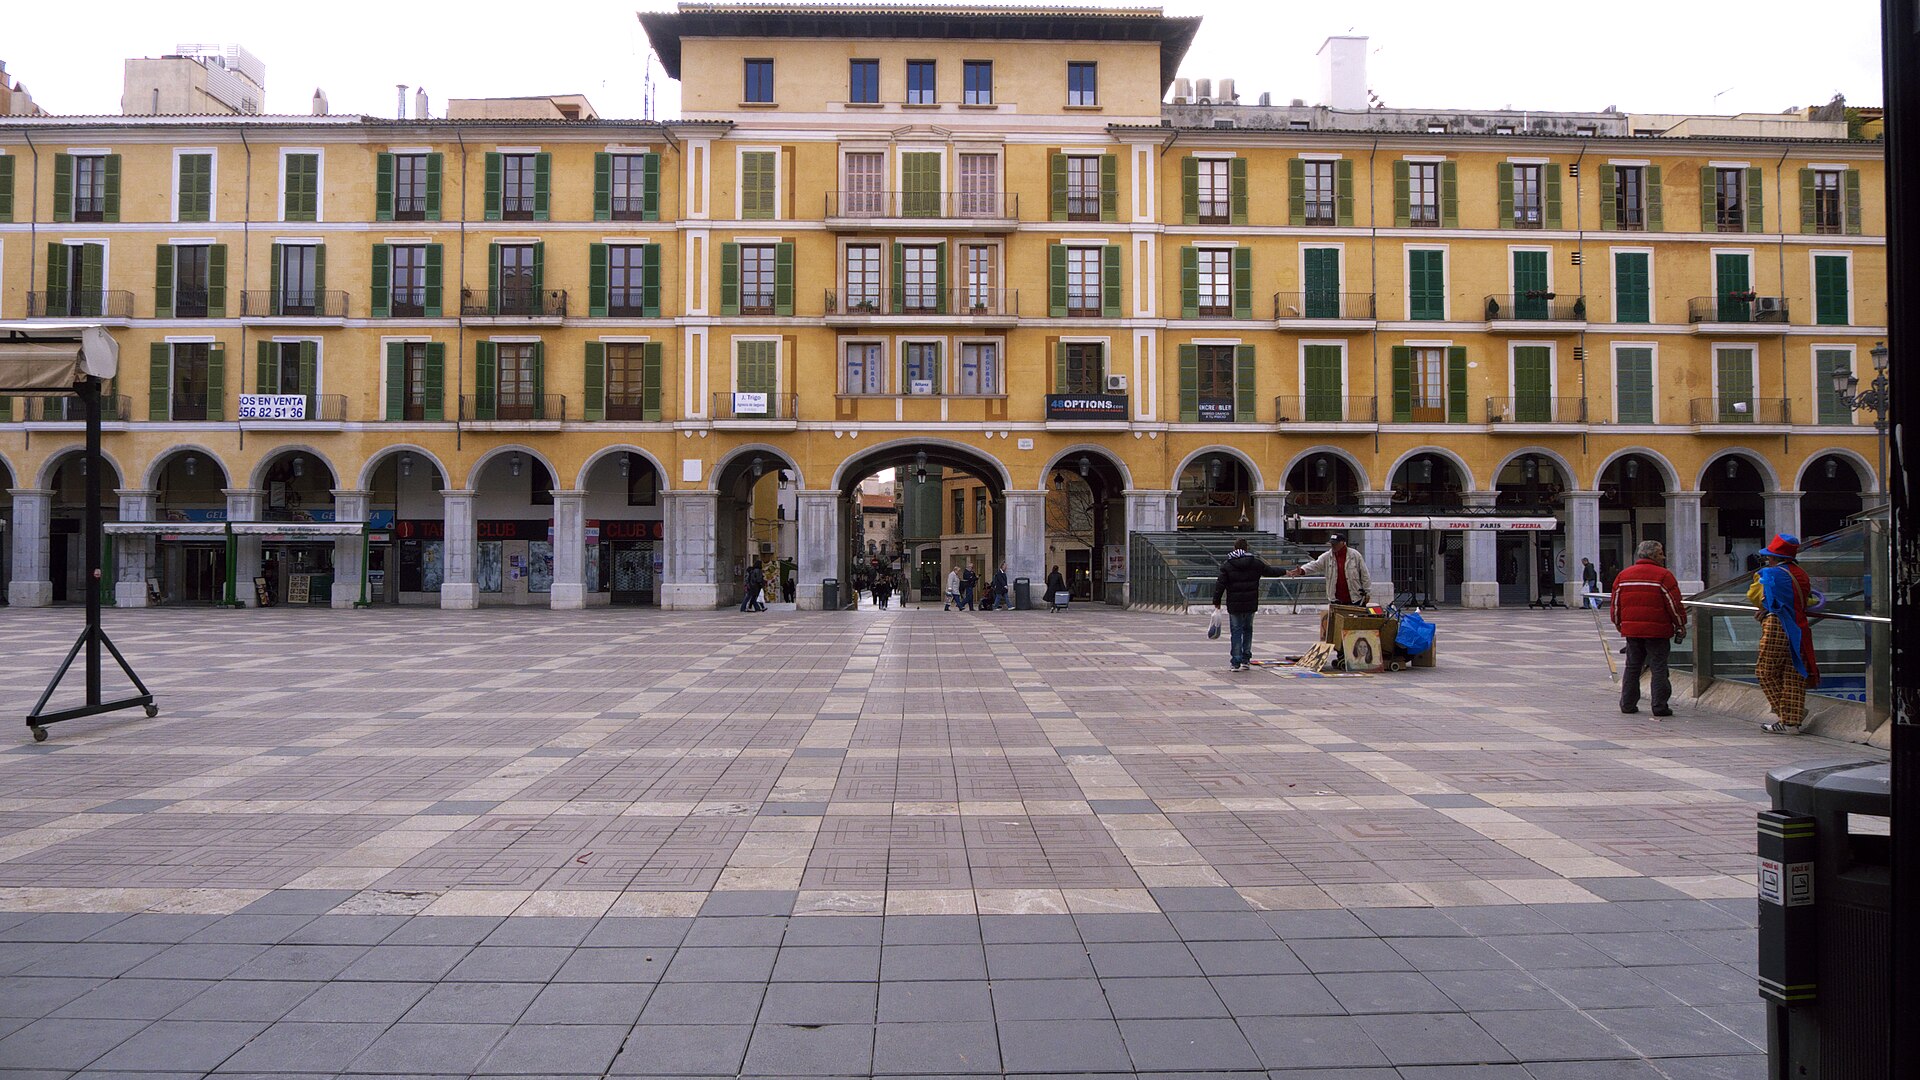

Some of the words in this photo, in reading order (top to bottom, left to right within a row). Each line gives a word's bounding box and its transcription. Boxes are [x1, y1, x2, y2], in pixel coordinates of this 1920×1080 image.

[258, 397, 271, 405] EN
[273, 397, 303, 406] VENTA
[258, 407, 272, 417] 82
[274, 408, 286, 417] 51
[290, 408, 303, 417] 36
[206, 511, 227, 519] GEL
[422, 523, 445, 537] TA
[478, 522, 516, 537] CLUB
[607, 523, 647, 538] CLUB
